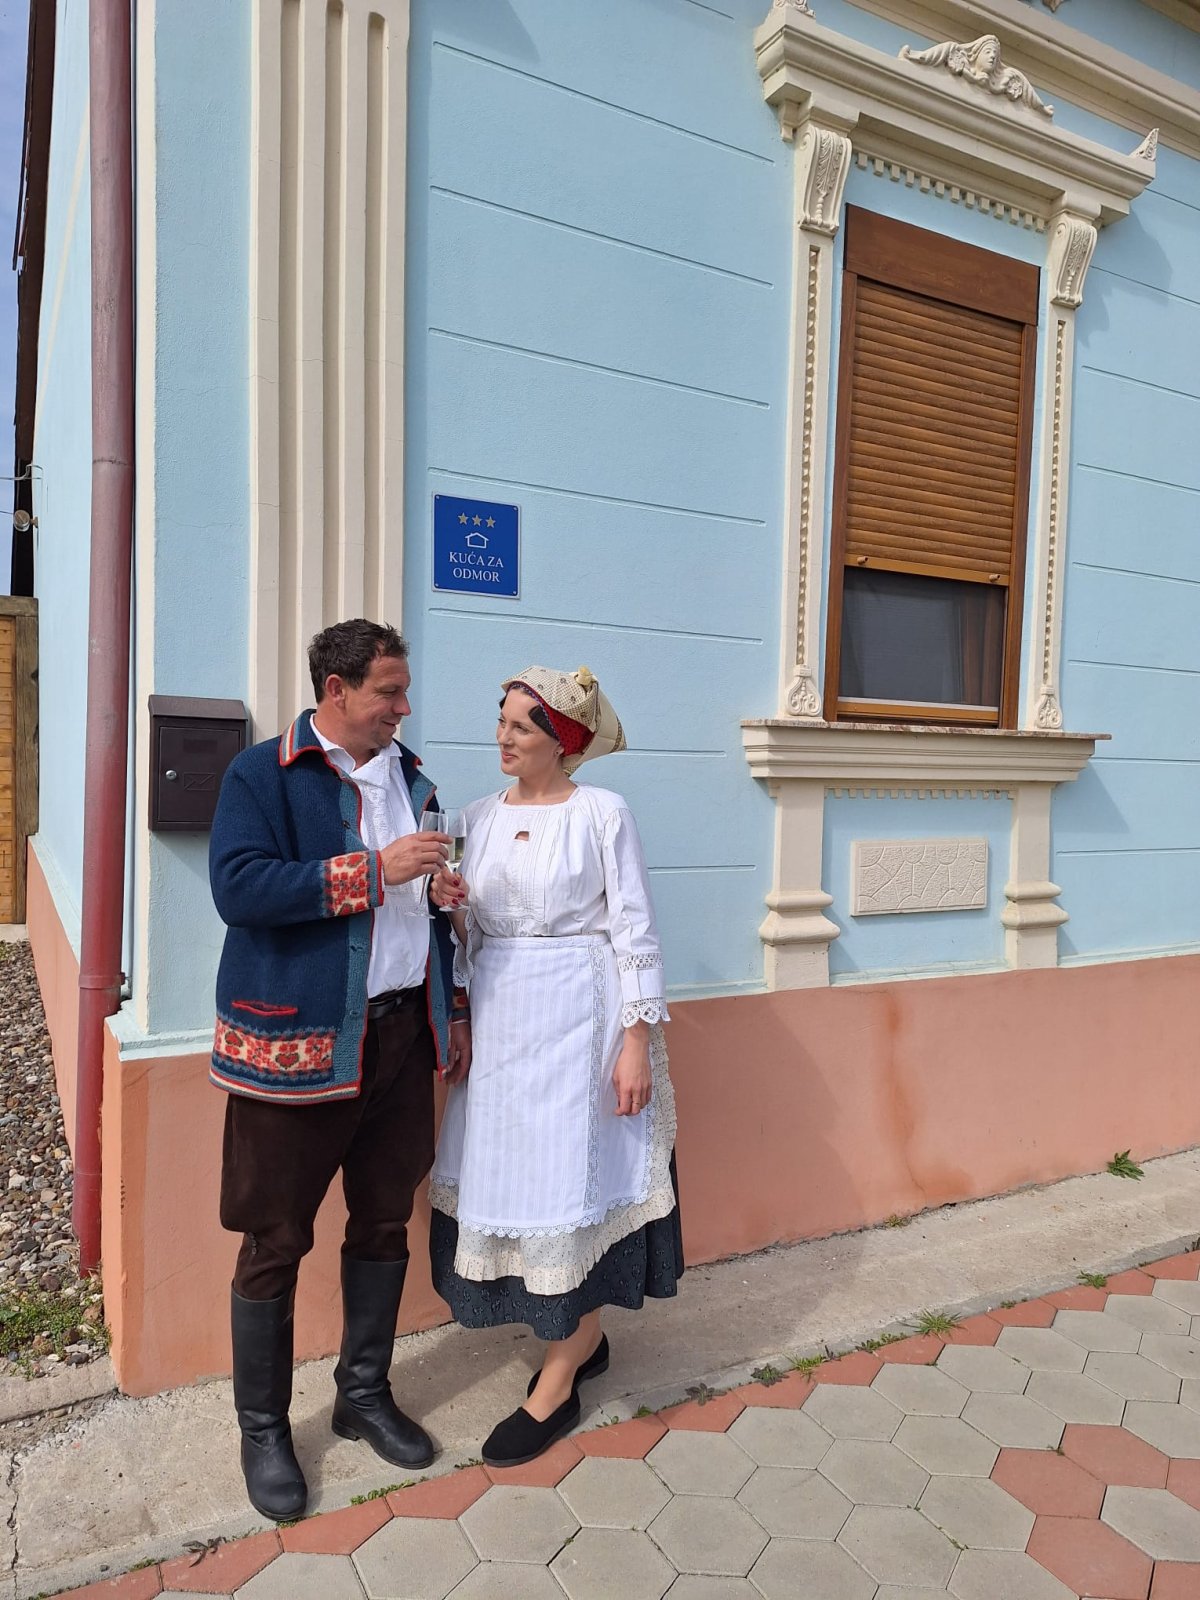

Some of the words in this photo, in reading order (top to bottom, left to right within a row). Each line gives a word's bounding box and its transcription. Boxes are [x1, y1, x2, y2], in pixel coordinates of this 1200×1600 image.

[449, 551, 485, 566] KUĆA
[487, 556, 504, 568] ZA
[453, 567, 500, 582] ODMOR
